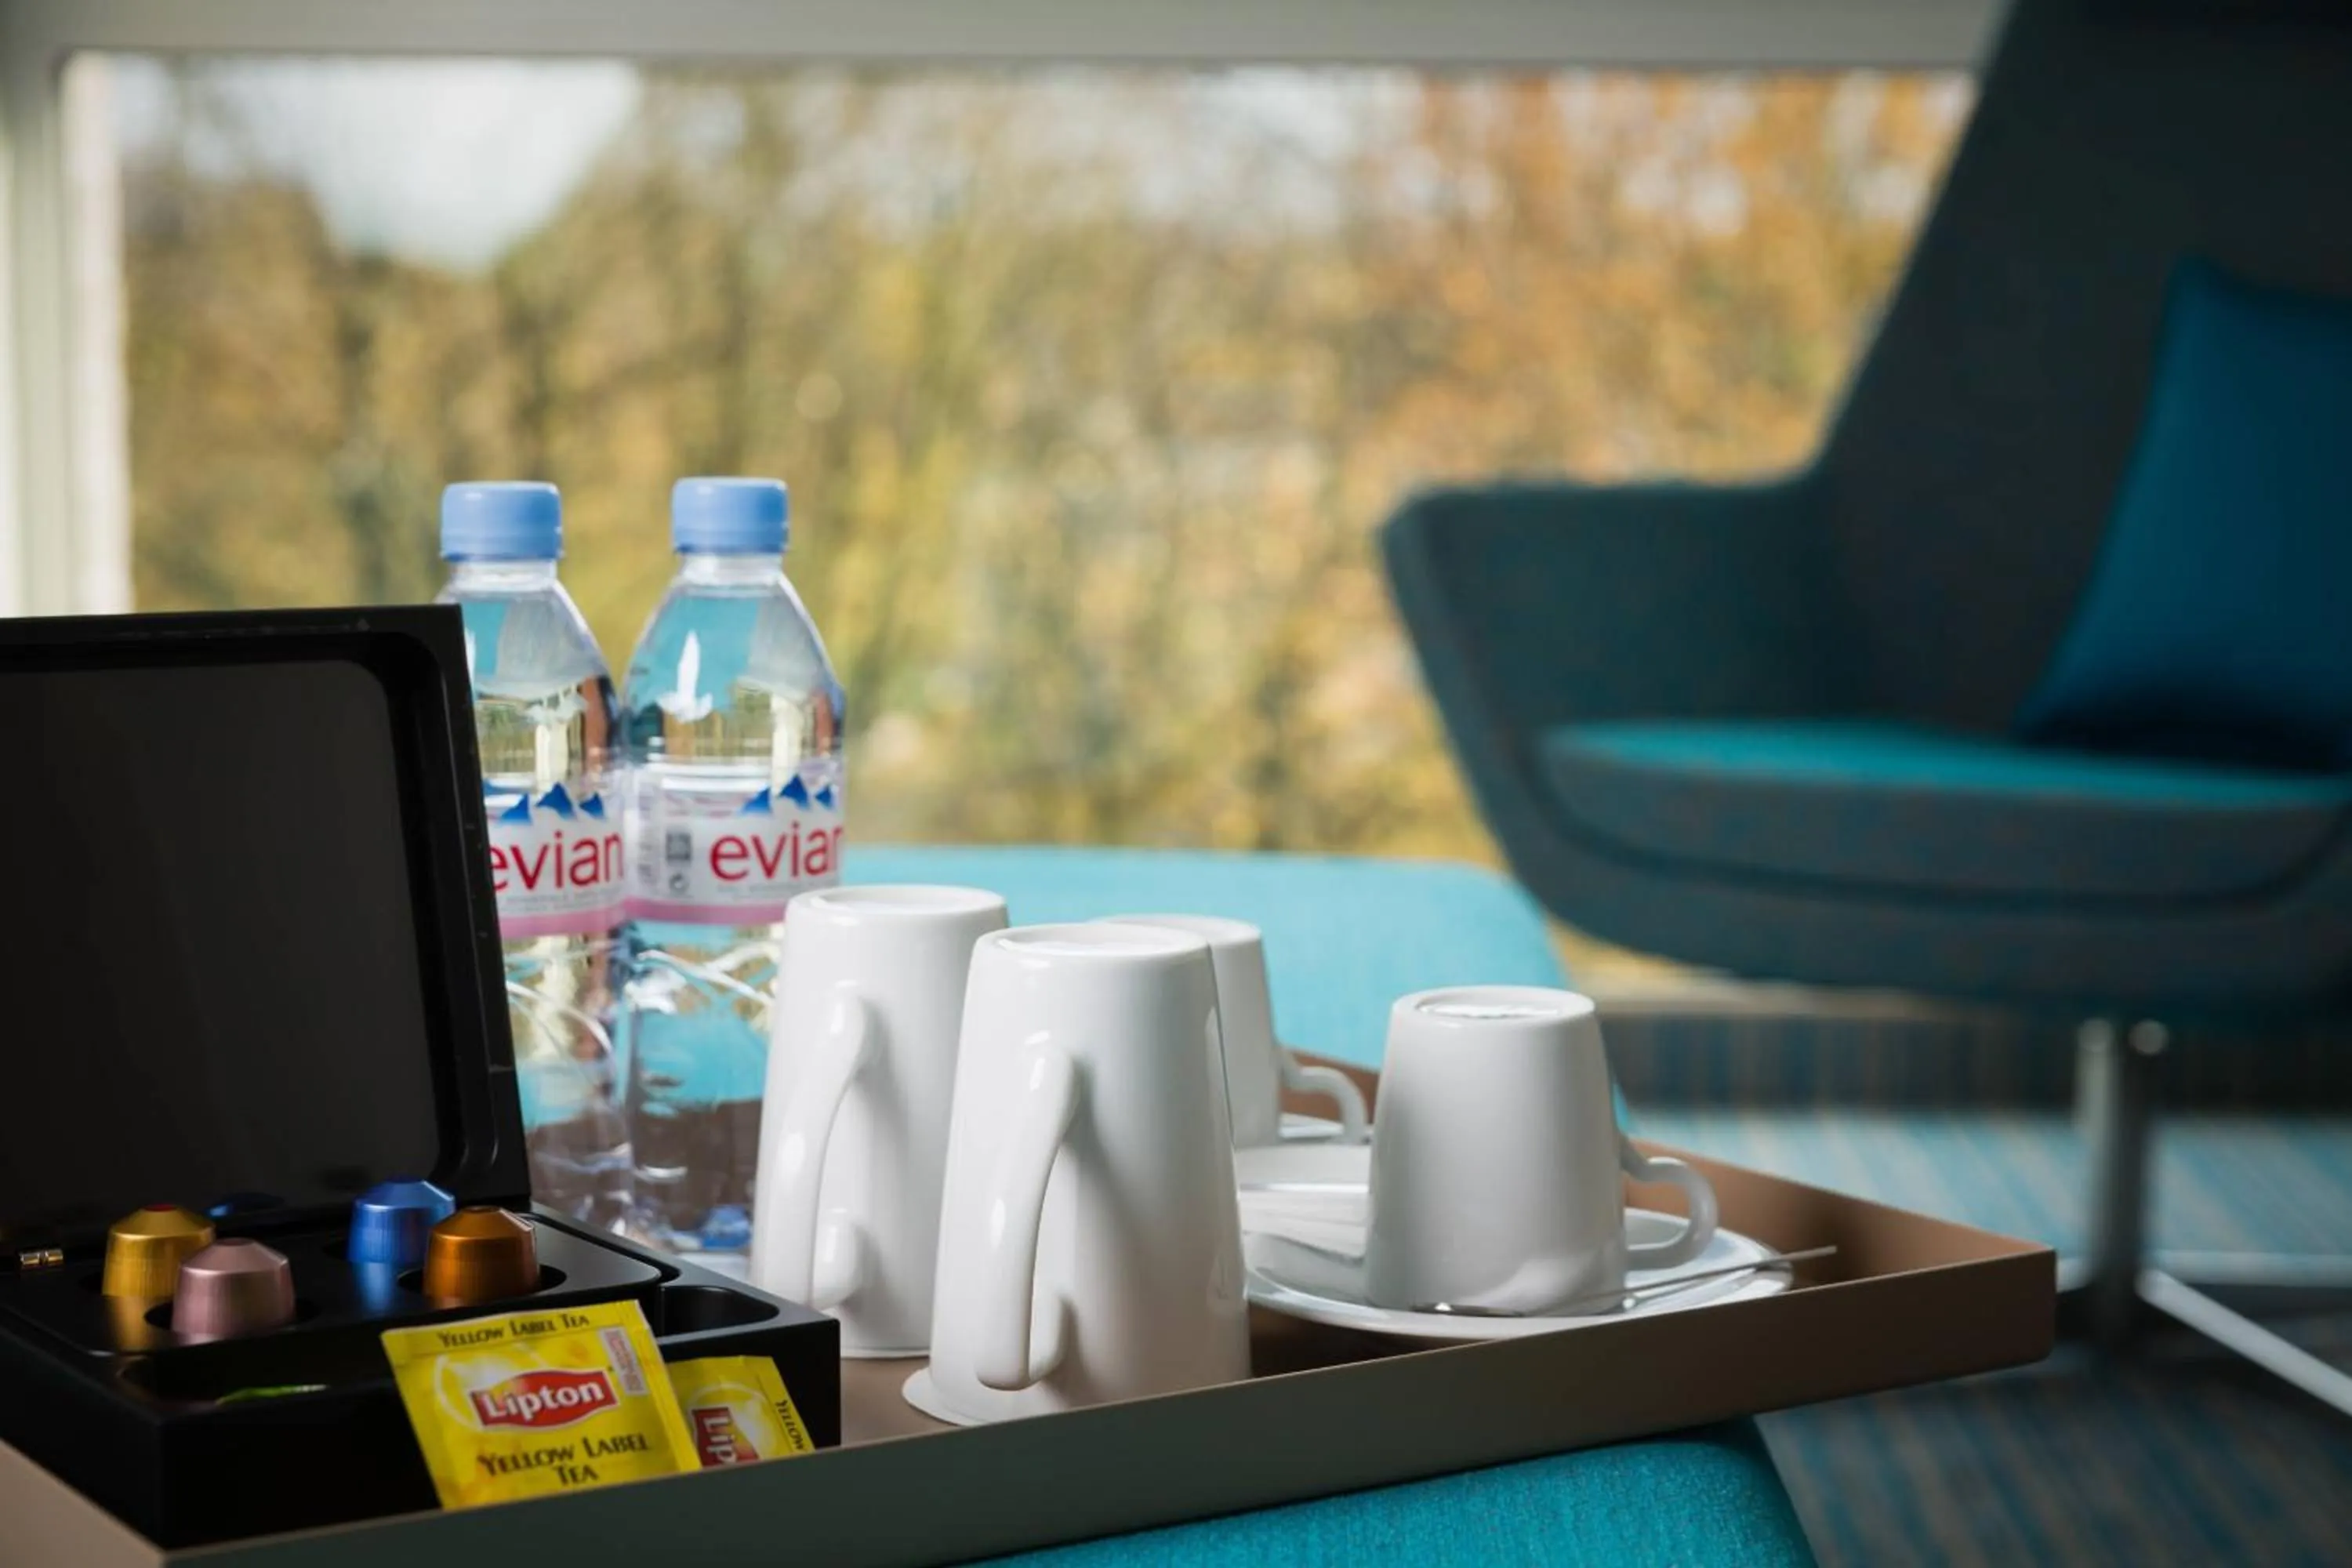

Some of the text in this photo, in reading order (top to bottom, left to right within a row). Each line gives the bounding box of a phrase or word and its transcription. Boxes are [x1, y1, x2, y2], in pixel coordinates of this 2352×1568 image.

[438, 1313, 590, 1347] YELLOW LABEL TEA
[481, 1381, 604, 1421] Lipton
[775, 1399, 804, 1450] YELLOW
[476, 1432, 648, 1476] YELLOW LABEL
[553, 1465, 599, 1486] TEA
